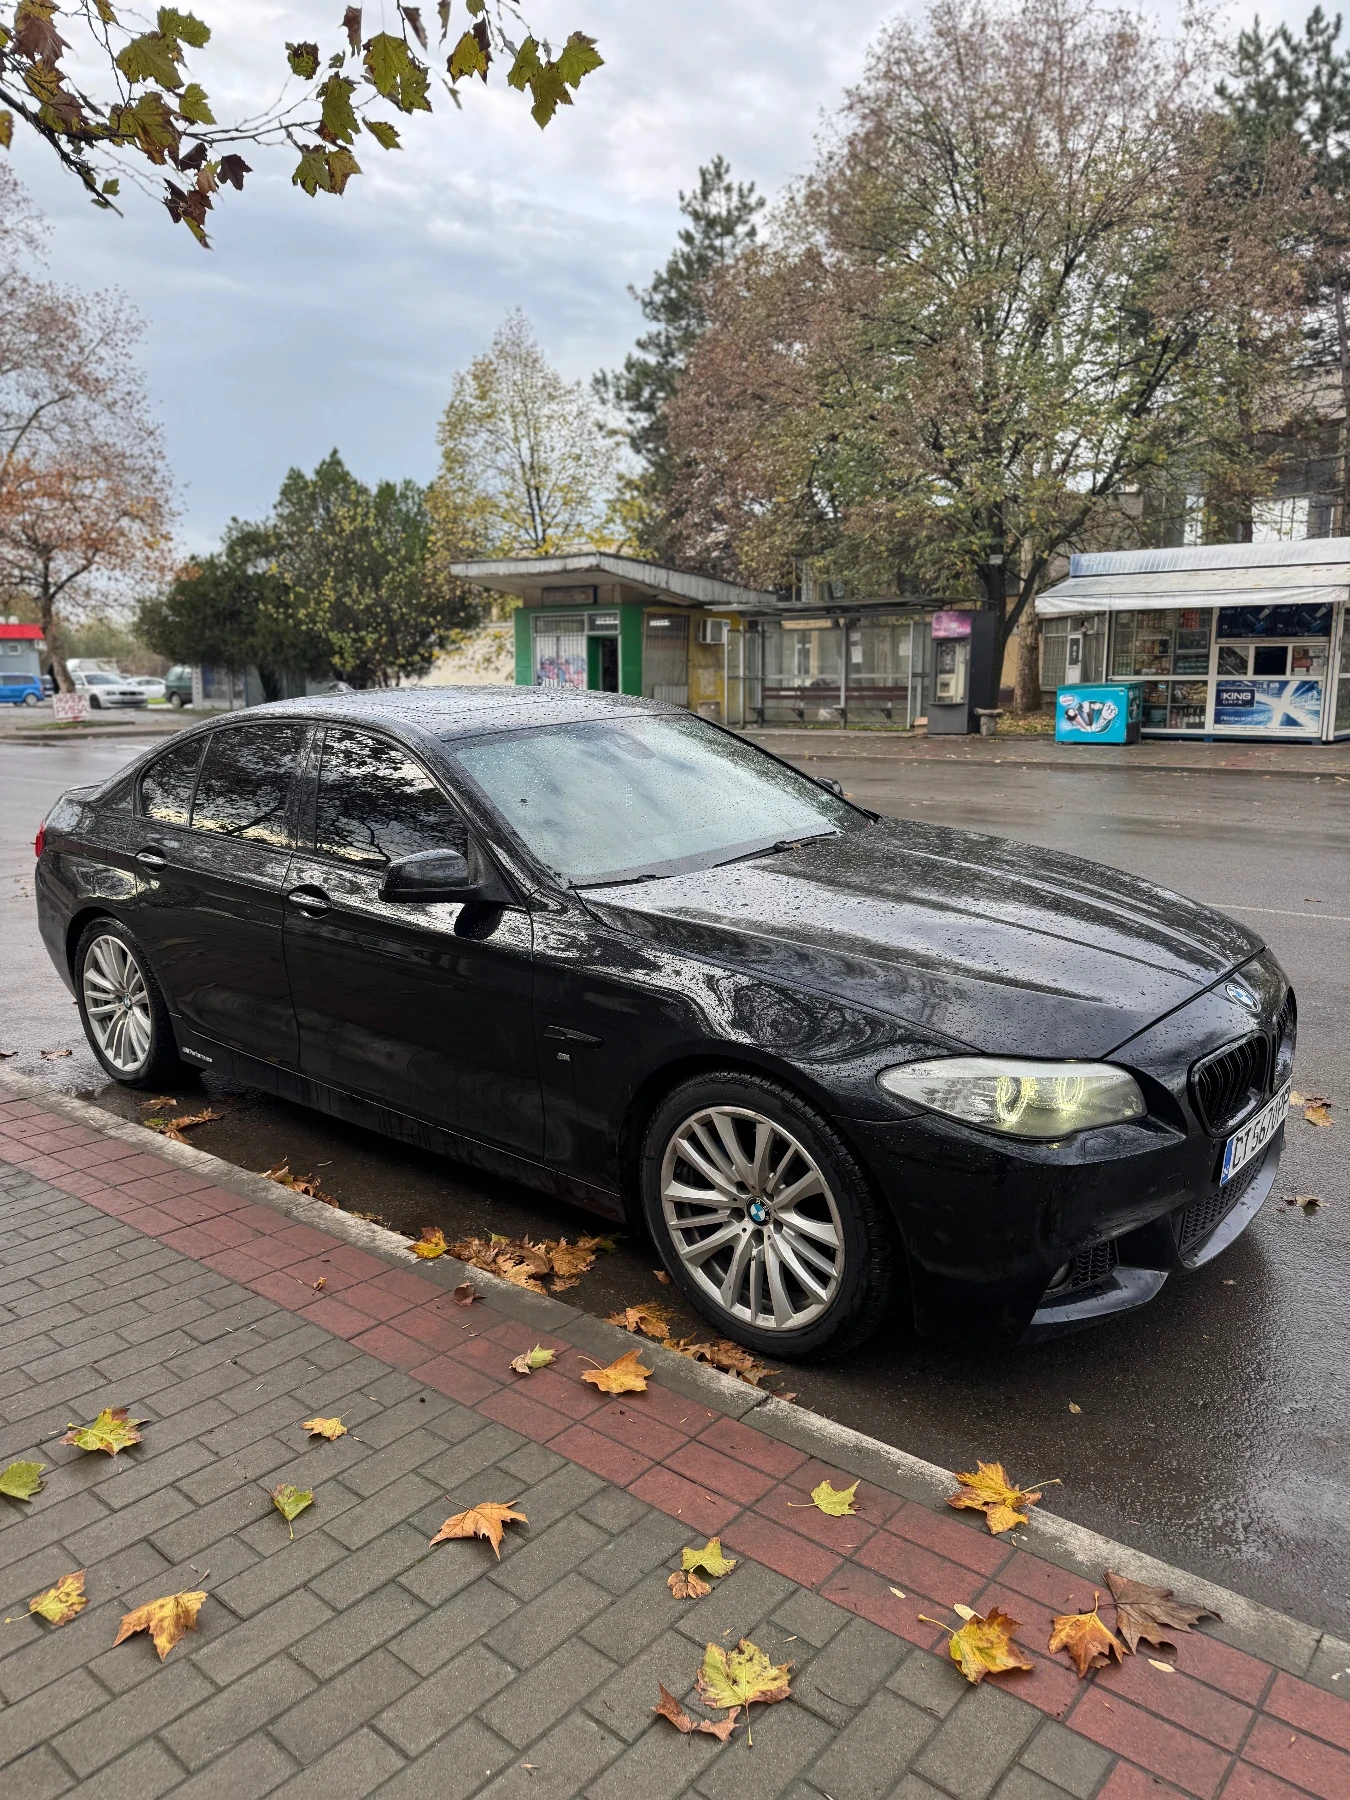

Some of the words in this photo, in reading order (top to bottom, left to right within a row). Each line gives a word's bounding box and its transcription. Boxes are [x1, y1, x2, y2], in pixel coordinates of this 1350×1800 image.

[55, 694, 88, 704] ЖИВА
[1223, 692, 1251, 700] KING
[56, 704, 88, 716] РИБА
[1232, 1126, 1252, 1170] CT
